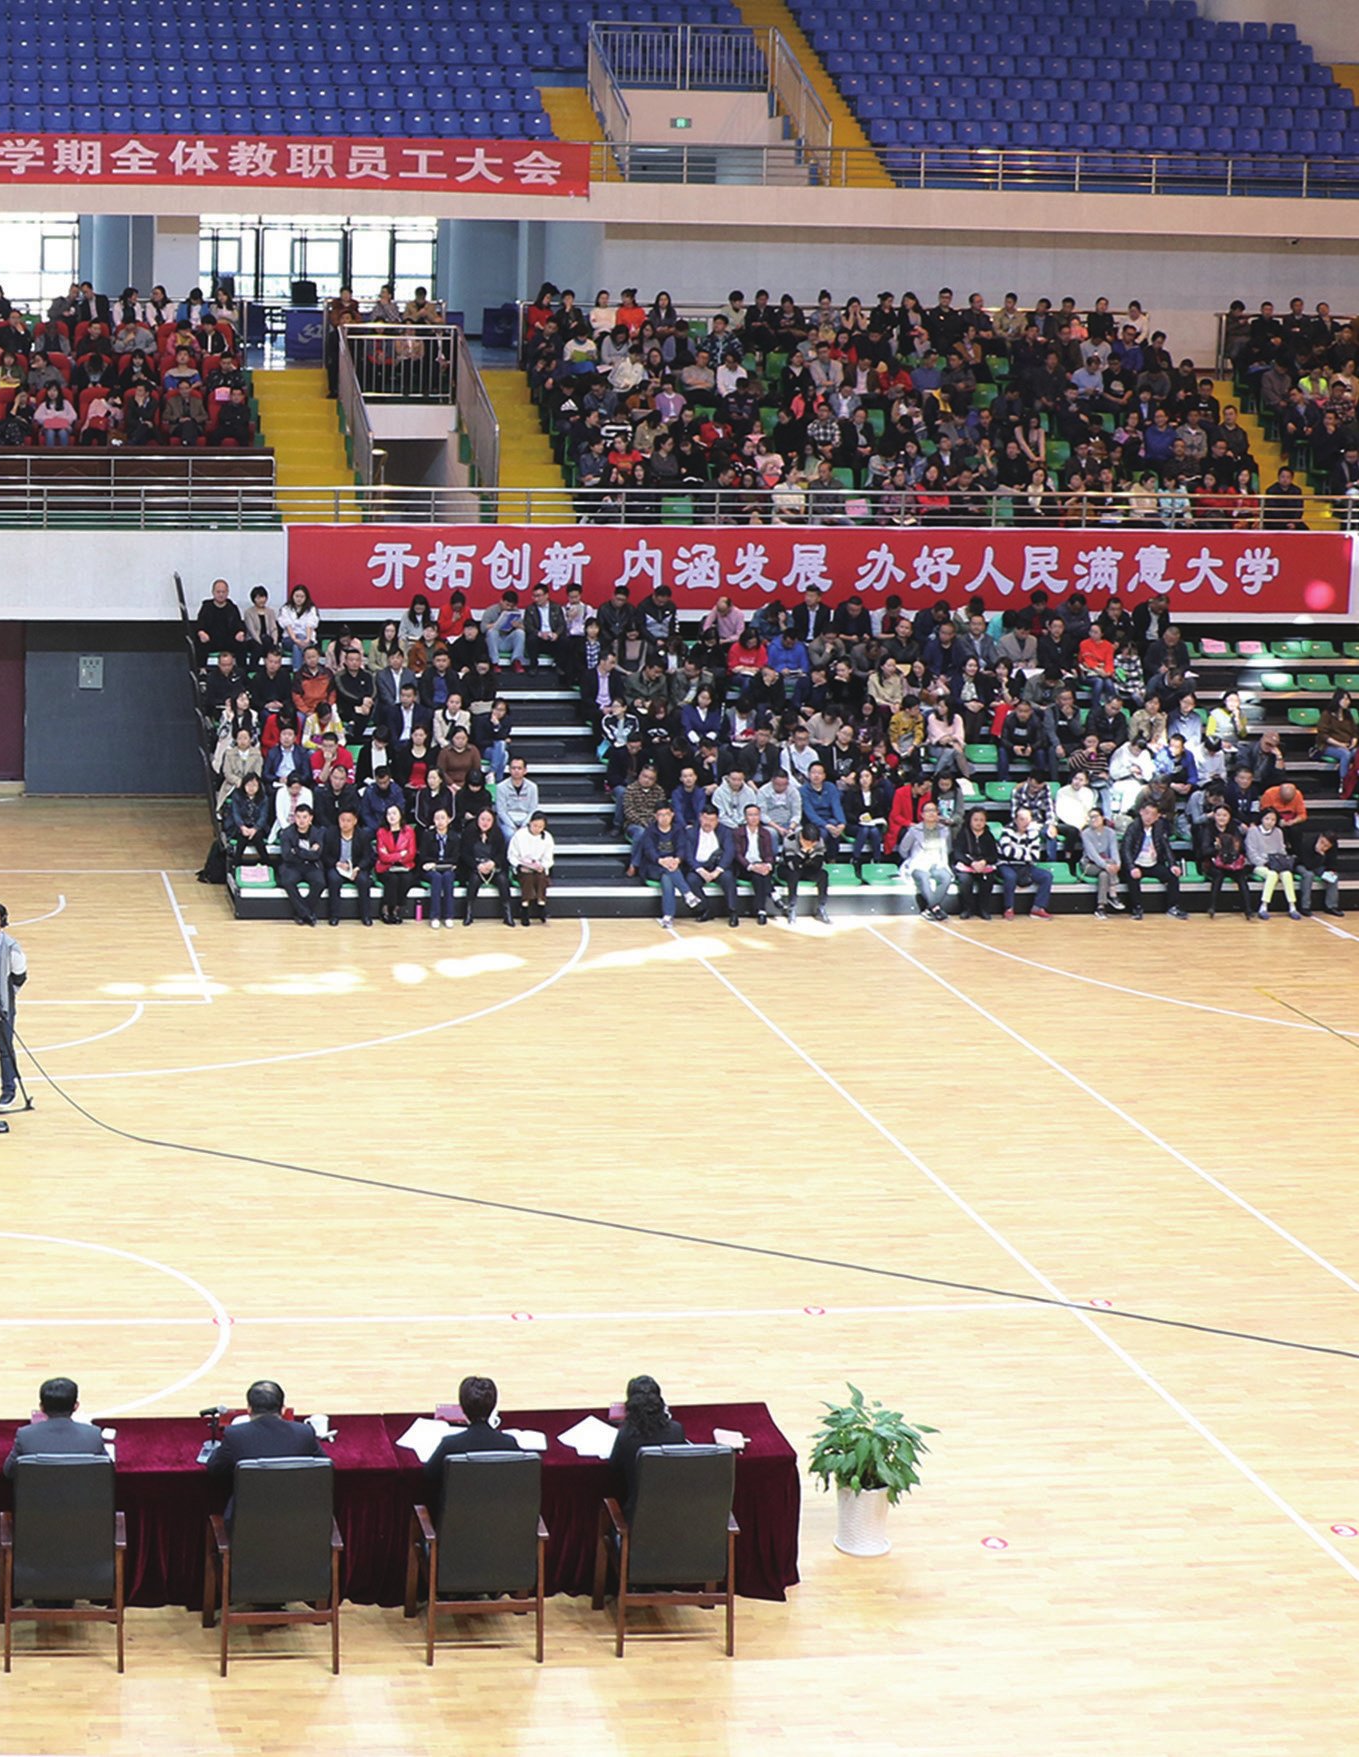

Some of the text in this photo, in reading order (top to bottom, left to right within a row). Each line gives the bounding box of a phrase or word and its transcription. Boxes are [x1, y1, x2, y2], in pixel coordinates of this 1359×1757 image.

[367, 539, 1280, 595] 开拓创新 内涵发展 办好人民满意大学
